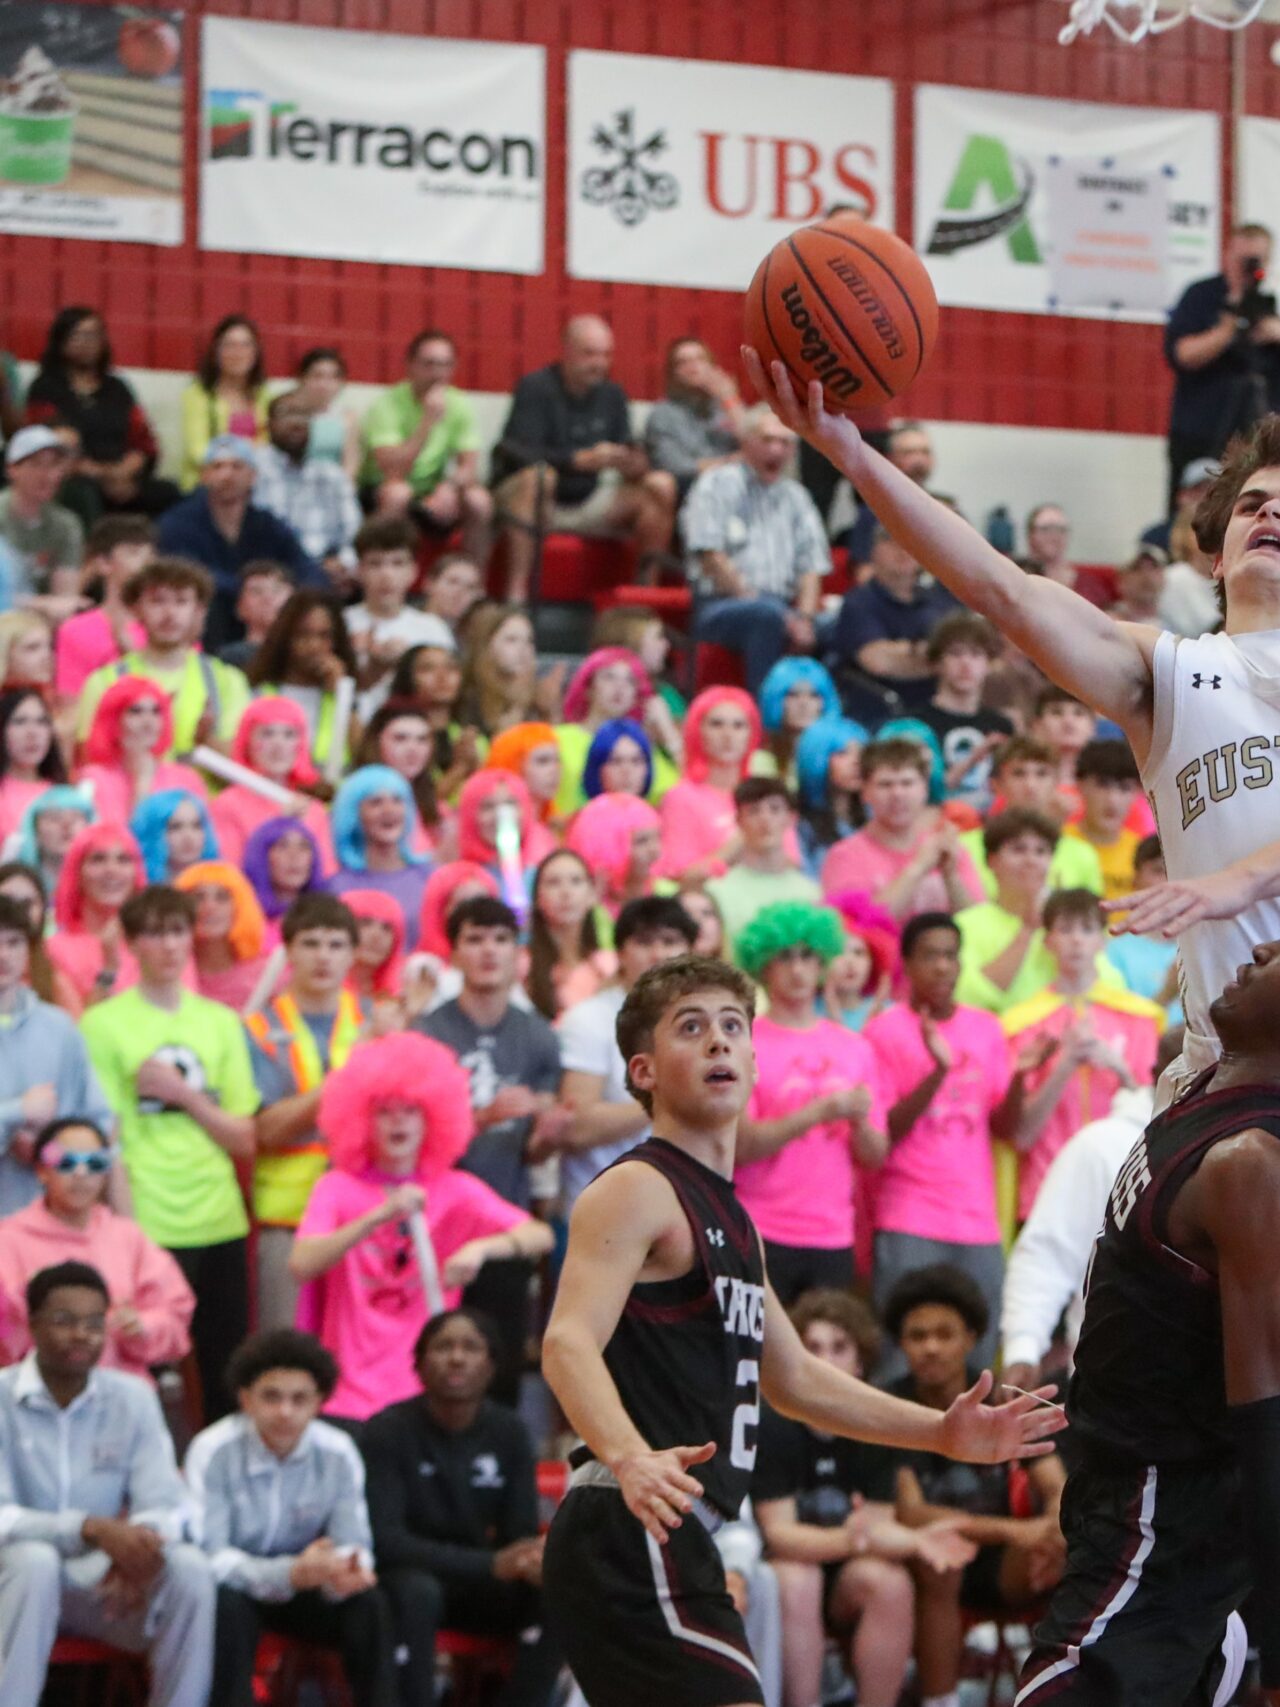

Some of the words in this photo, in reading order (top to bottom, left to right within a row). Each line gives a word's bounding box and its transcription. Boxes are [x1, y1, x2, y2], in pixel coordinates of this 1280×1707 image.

[214, 90, 536, 178] Terracon
[697, 129, 878, 222] UBS
[781, 282, 863, 400] Wilson
[827, 256, 901, 360] EVOLUTION
[730, 1359, 761, 1472] 2
